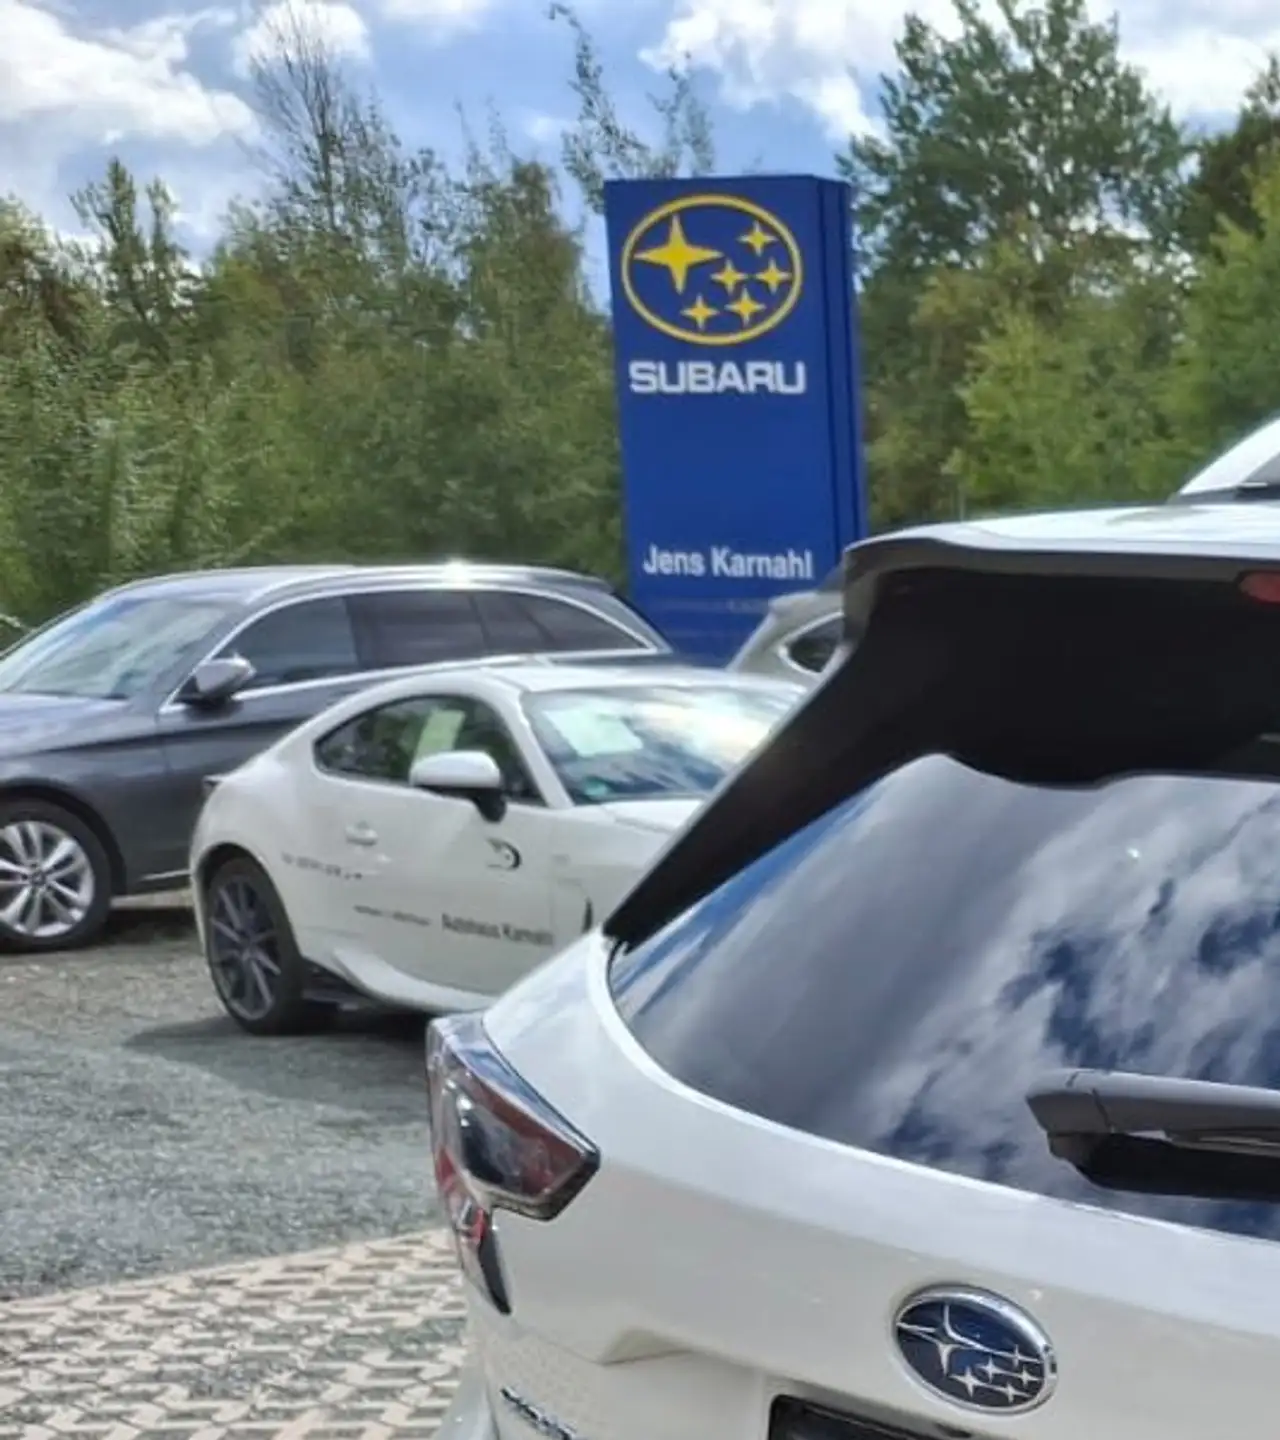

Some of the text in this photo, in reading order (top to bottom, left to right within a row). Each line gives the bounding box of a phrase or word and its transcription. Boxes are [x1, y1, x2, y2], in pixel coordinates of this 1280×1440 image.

[629, 361, 806, 394] SUBARU
[643, 545, 813, 579] Jens Karnahl
